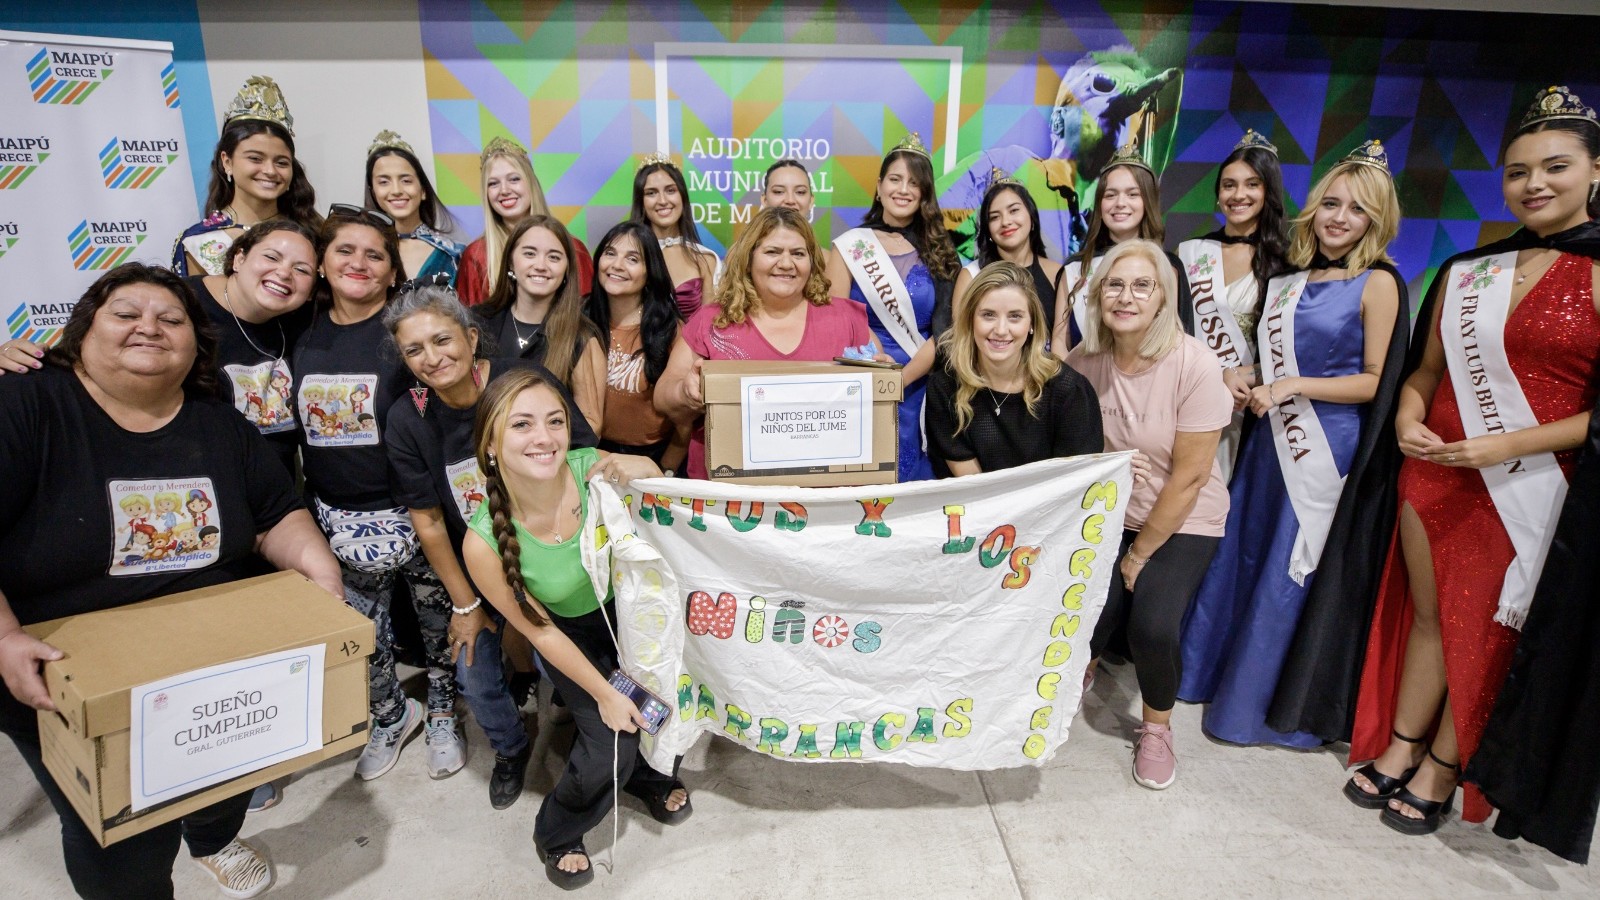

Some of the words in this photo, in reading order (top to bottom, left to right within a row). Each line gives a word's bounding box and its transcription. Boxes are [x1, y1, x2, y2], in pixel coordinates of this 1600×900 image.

[51, 50, 114, 67] MAIPÚ
[55, 67, 97, 78] CRECE
[121, 138, 179, 152] MAIPÚ
[688, 137, 830, 160] AUDITORIO
[0, 153, 33, 162] RECE
[124, 154, 163, 164] CRECE
[688, 170, 834, 193] MUNIAL
[691, 203, 721, 223] DE
[91, 218, 148, 233] MAIPÚ
[94, 235, 133, 245] CRECE
[29, 302, 77, 316] MAIP
[1459, 294, 1479, 339] FRAY
[1190, 277, 1242, 368] RUSSE
[1464, 343, 1488, 387] LUIS
[877, 379, 896, 394] 20
[1267, 311, 1312, 463] LUZUIAGA
[762, 411, 803, 422] JUNTOS
[805, 410, 826, 420] POR
[828, 409, 847, 420] LOS
[761, 421, 794, 434] NIÑOS
[796, 423, 817, 432] DEL
[818, 421, 847, 432] JUME
[1475, 388, 1527, 474] BELTN
[448, 461, 477, 475] Comedor
[115, 483, 157, 493] Comedor
[158, 485, 164, 493] y
[166, 481, 210, 491] Merendero
[619, 493, 808, 532] NTOS
[855, 497, 894, 537] X
[162, 552, 212, 563] Cumplido
[1022, 480, 1118, 760] MERENDERO
[340, 640, 360, 657] 13
[192, 689, 262, 721] SUEÑO
[676, 672, 974, 758] BARRANCAS
[174, 705, 278, 746] CUMPLIDO
[216, 724, 271, 747] GUTIERRREZ
